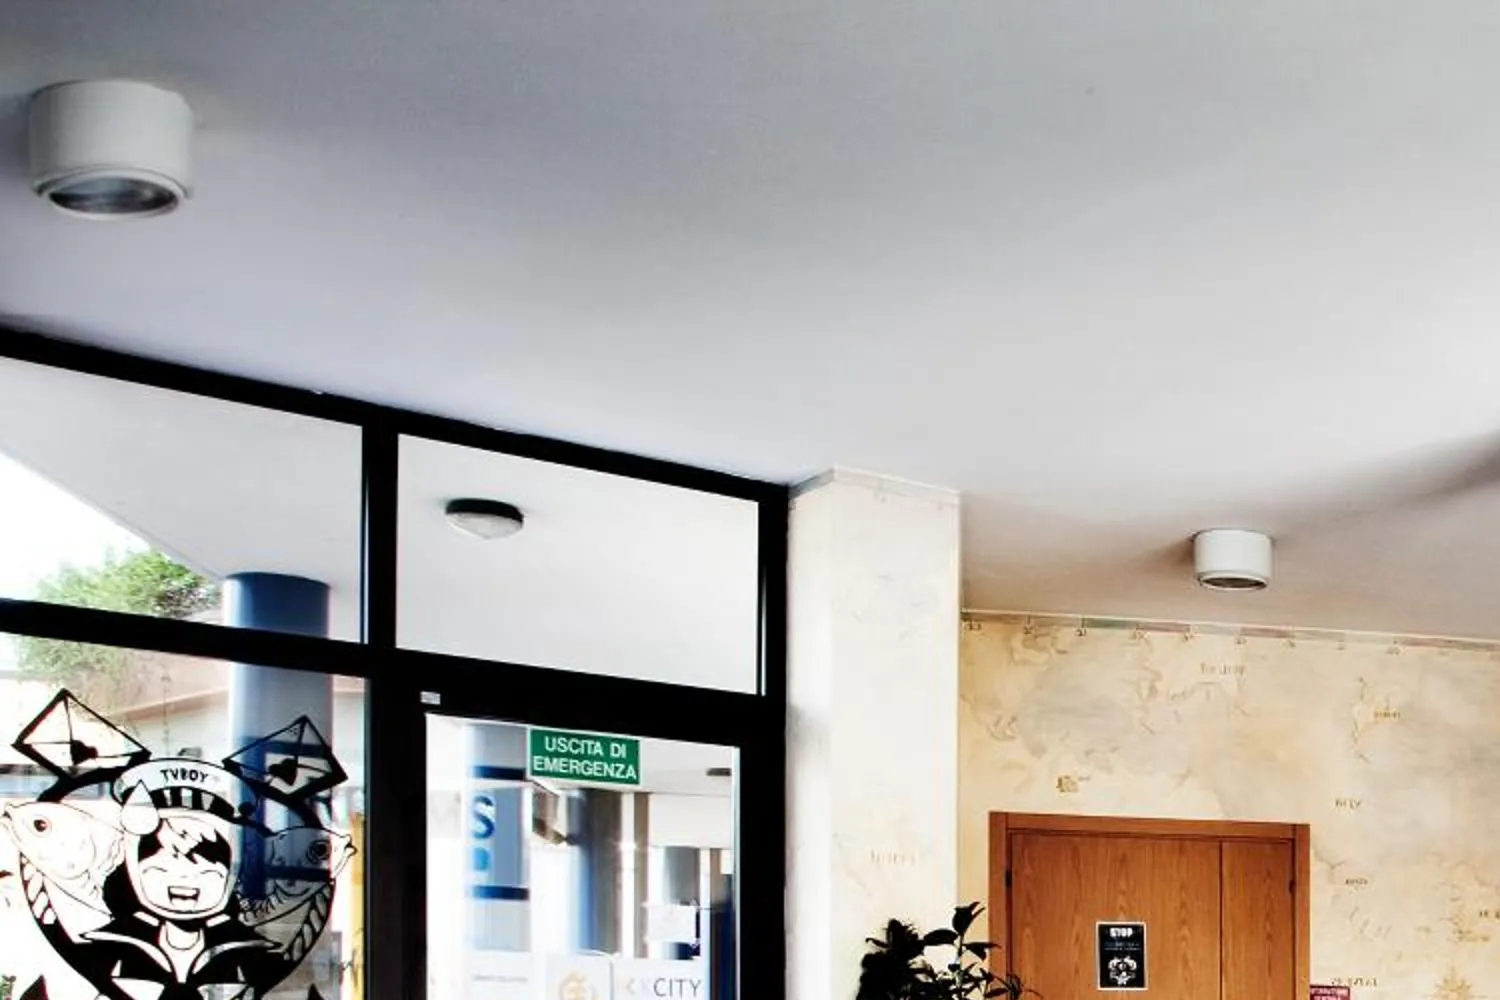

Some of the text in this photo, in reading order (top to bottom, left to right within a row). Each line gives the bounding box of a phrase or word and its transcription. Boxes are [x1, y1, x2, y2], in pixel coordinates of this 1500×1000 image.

[544, 736, 627, 759] USCITA DI
[159, 768, 209, 783] TVBOY
[532, 755, 637, 780] EMERGENZA
